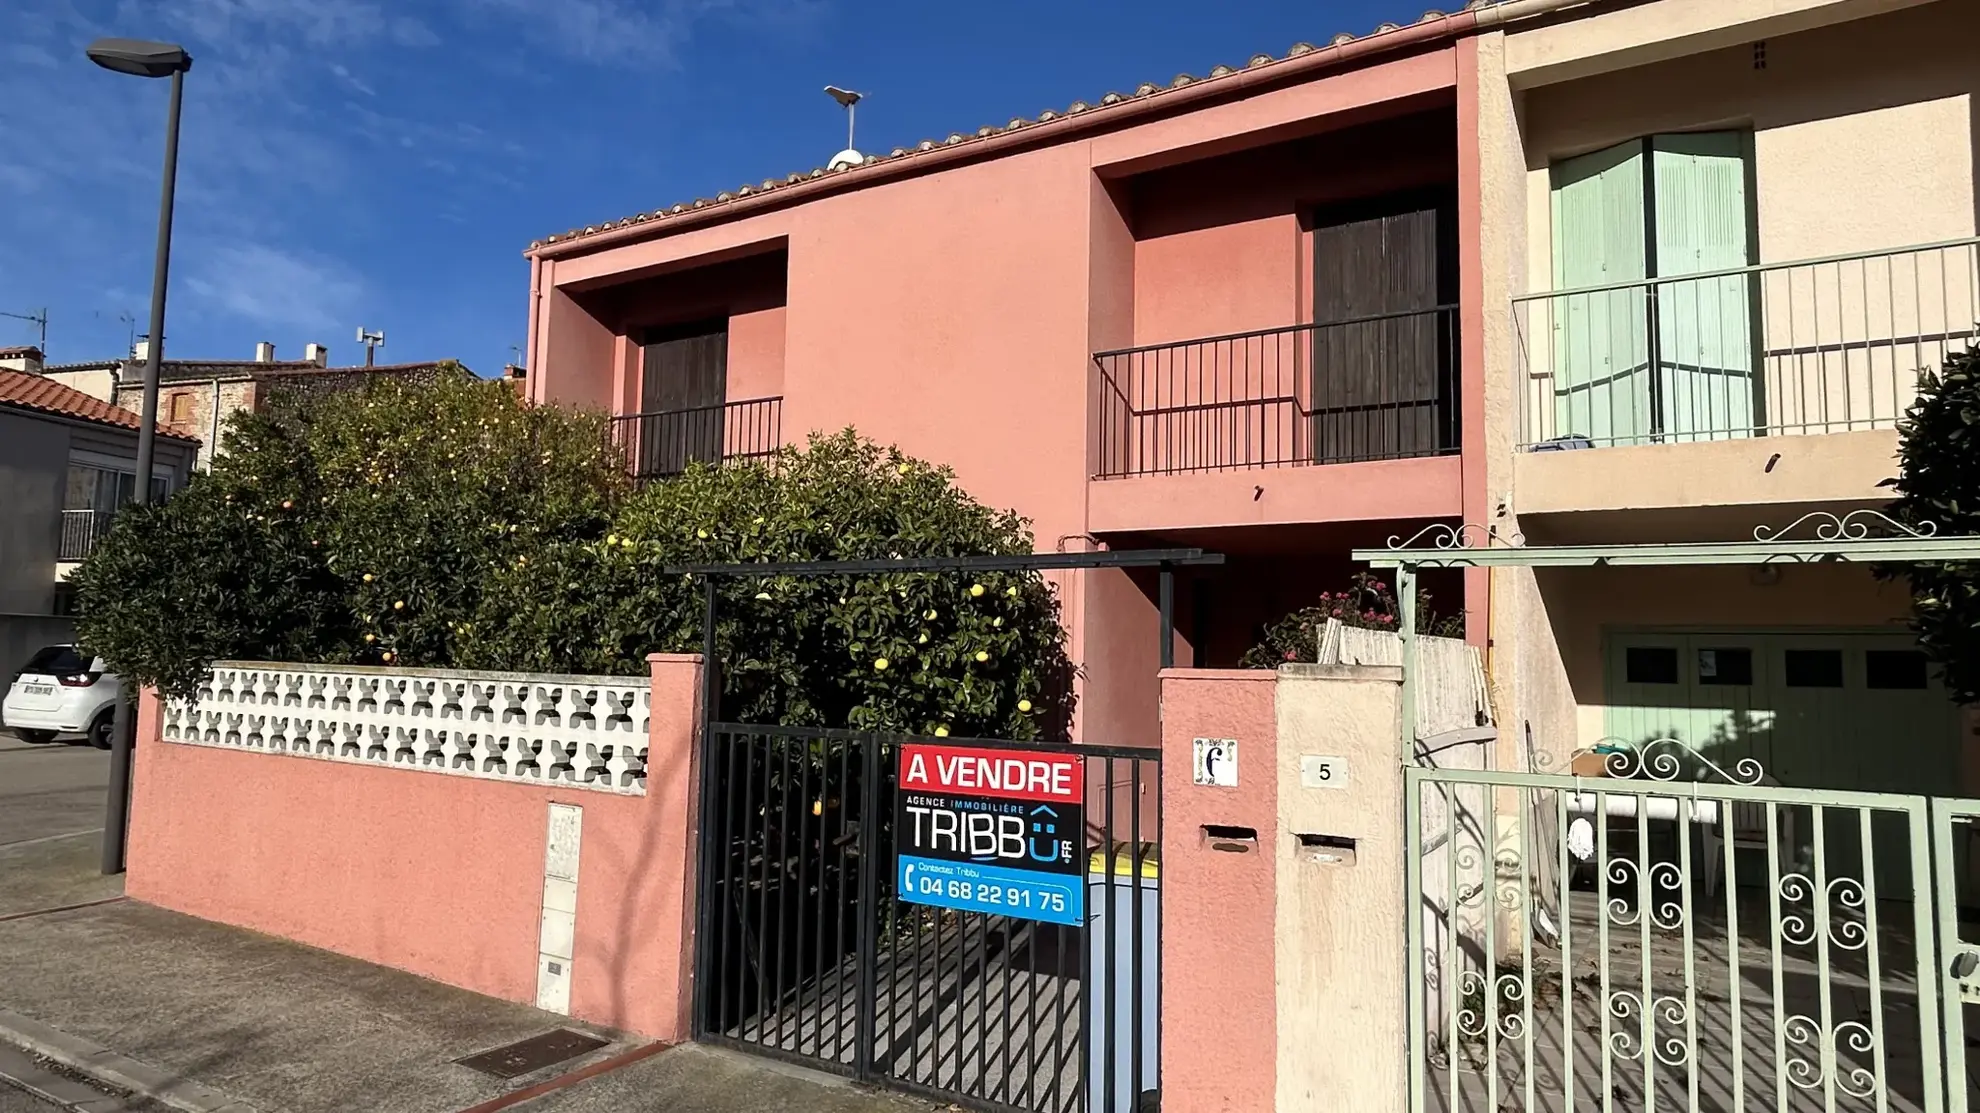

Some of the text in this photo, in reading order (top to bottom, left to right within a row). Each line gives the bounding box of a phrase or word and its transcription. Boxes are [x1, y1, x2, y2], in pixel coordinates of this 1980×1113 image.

[906, 753, 1072, 795] A VENDRE
[1319, 764, 1331, 780] 5
[906, 796, 1024, 815] AGENCE IMMOBILIÈRE
[918, 862, 980, 878] Contactez Tribbu
[920, 876, 1065, 912] 04 68 22 91 75
